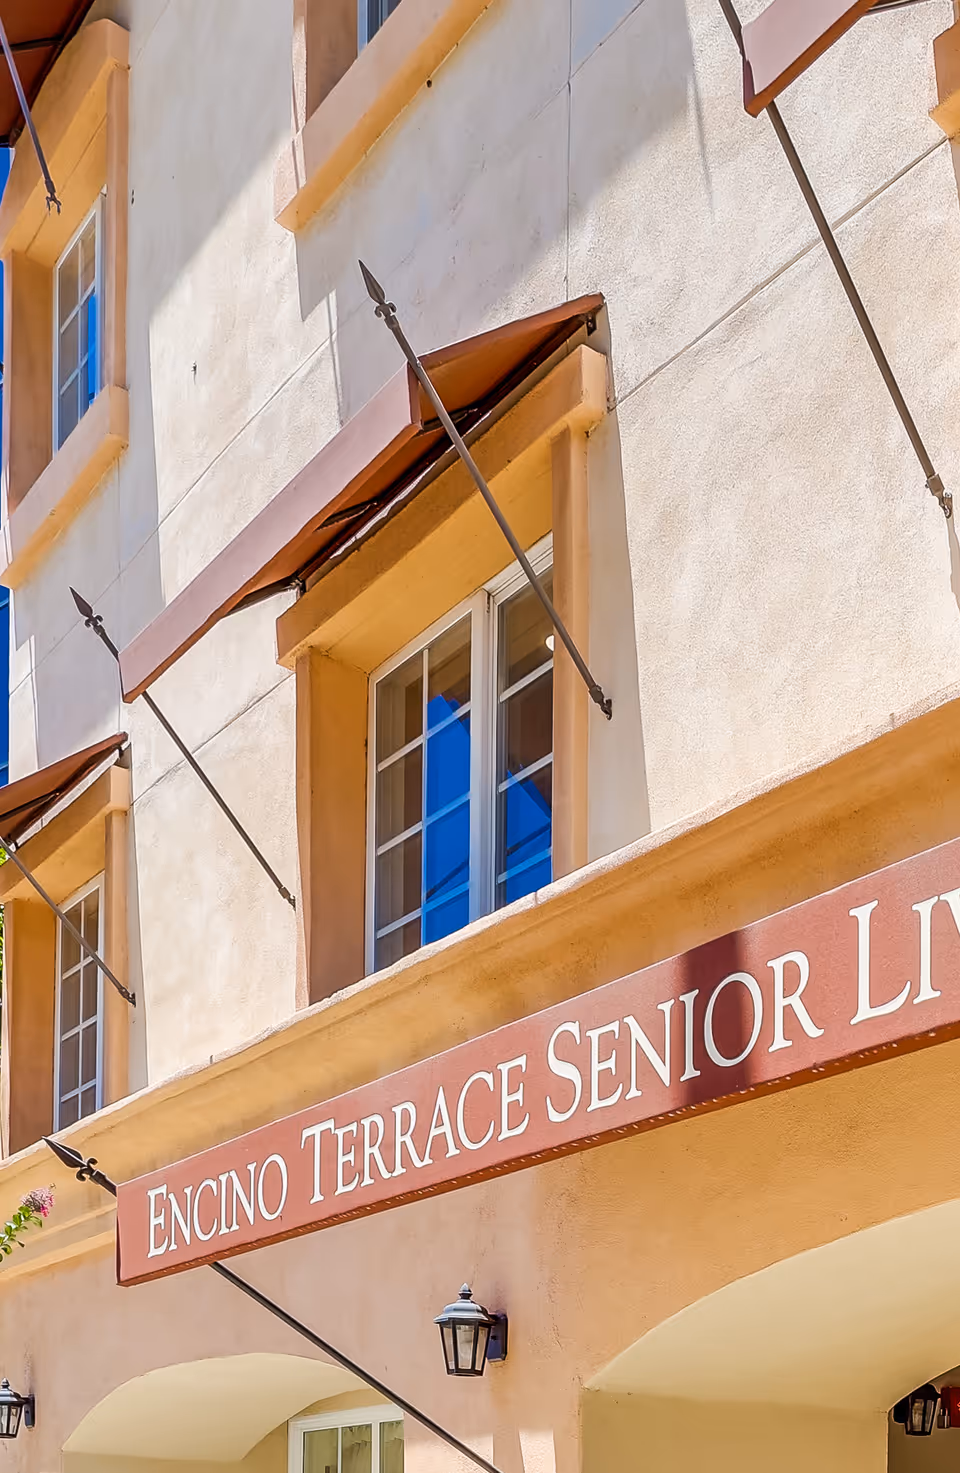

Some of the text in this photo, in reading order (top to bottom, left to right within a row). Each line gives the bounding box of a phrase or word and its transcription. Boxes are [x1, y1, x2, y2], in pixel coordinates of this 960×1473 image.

[147, 1153, 288, 1259] ENCINO
[300, 1053, 531, 1205] TERRACE
[545, 950, 825, 1123] SENIOR
